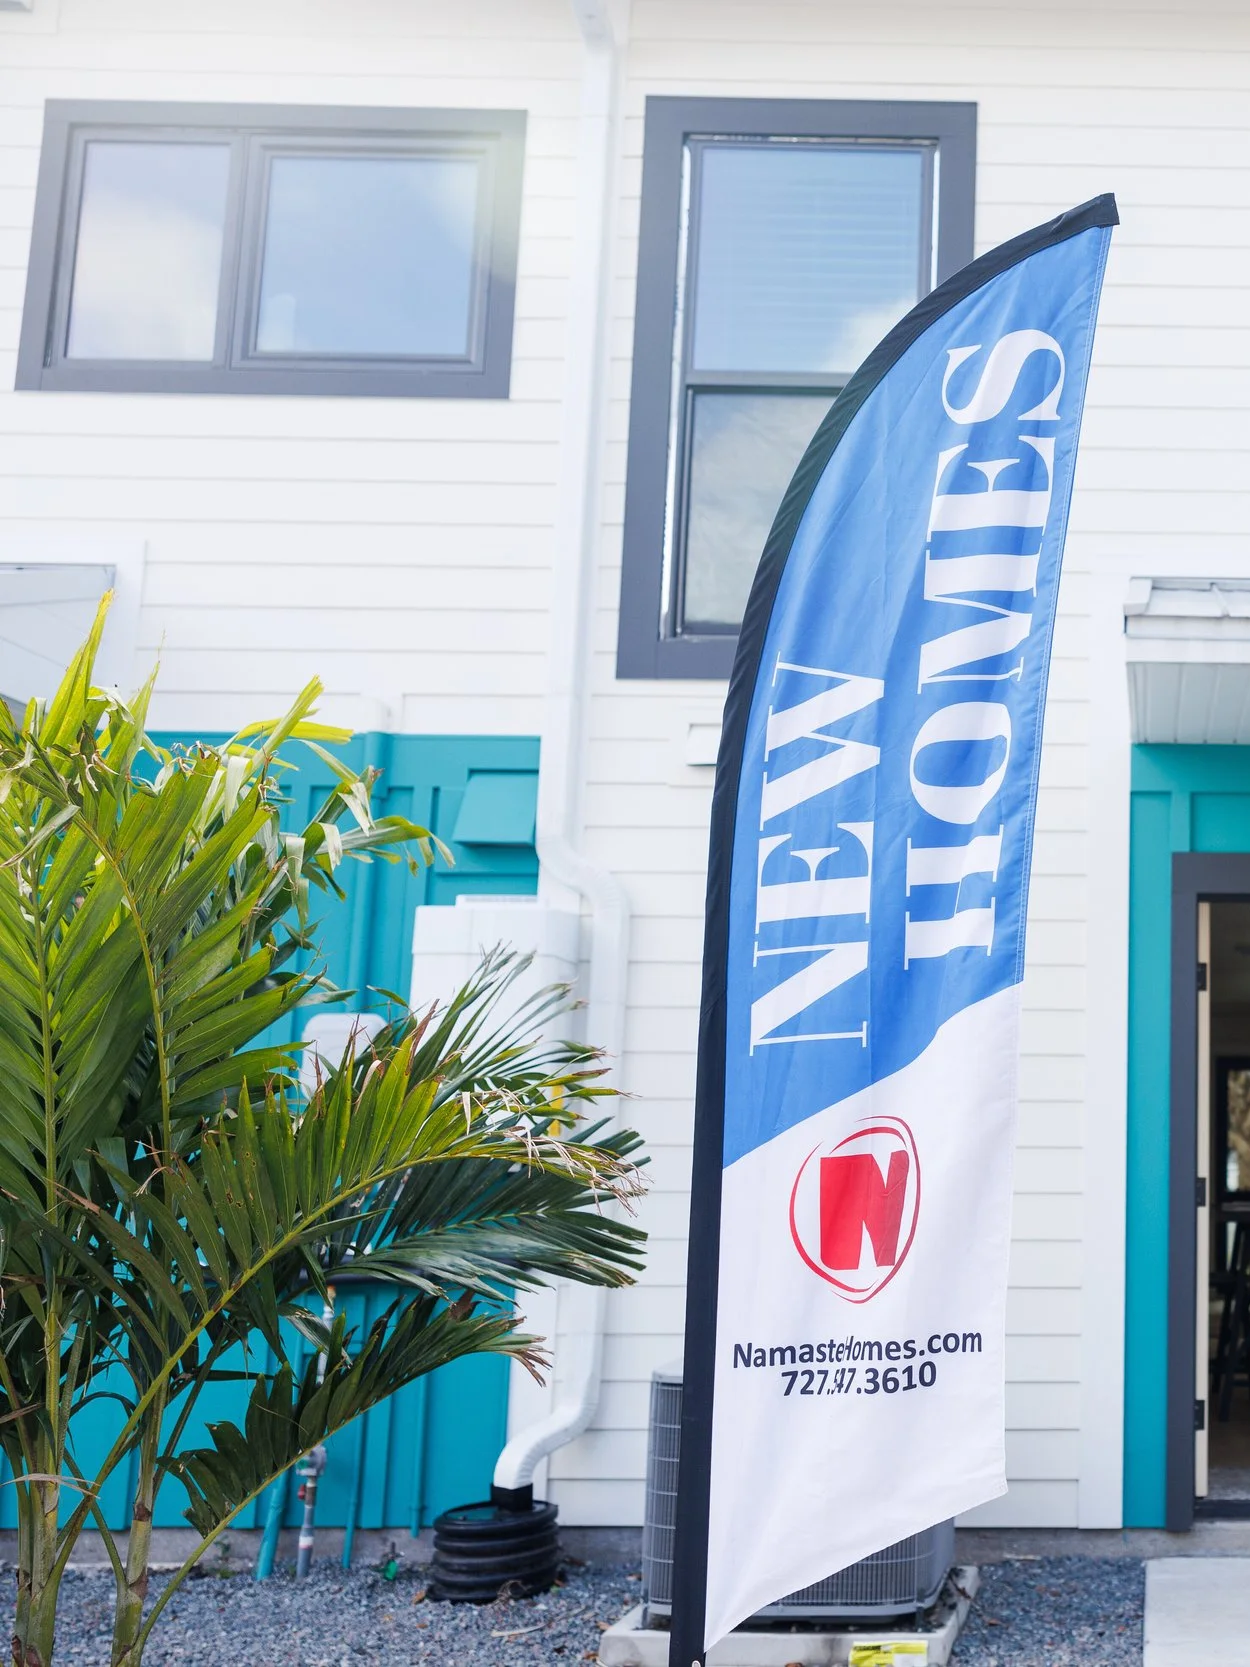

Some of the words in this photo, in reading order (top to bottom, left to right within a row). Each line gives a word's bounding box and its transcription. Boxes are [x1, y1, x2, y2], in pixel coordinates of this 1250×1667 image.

[904, 329, 1065, 971] HOMES
[749, 652, 885, 1056] NEW
[820, 1150, 910, 1270] N
